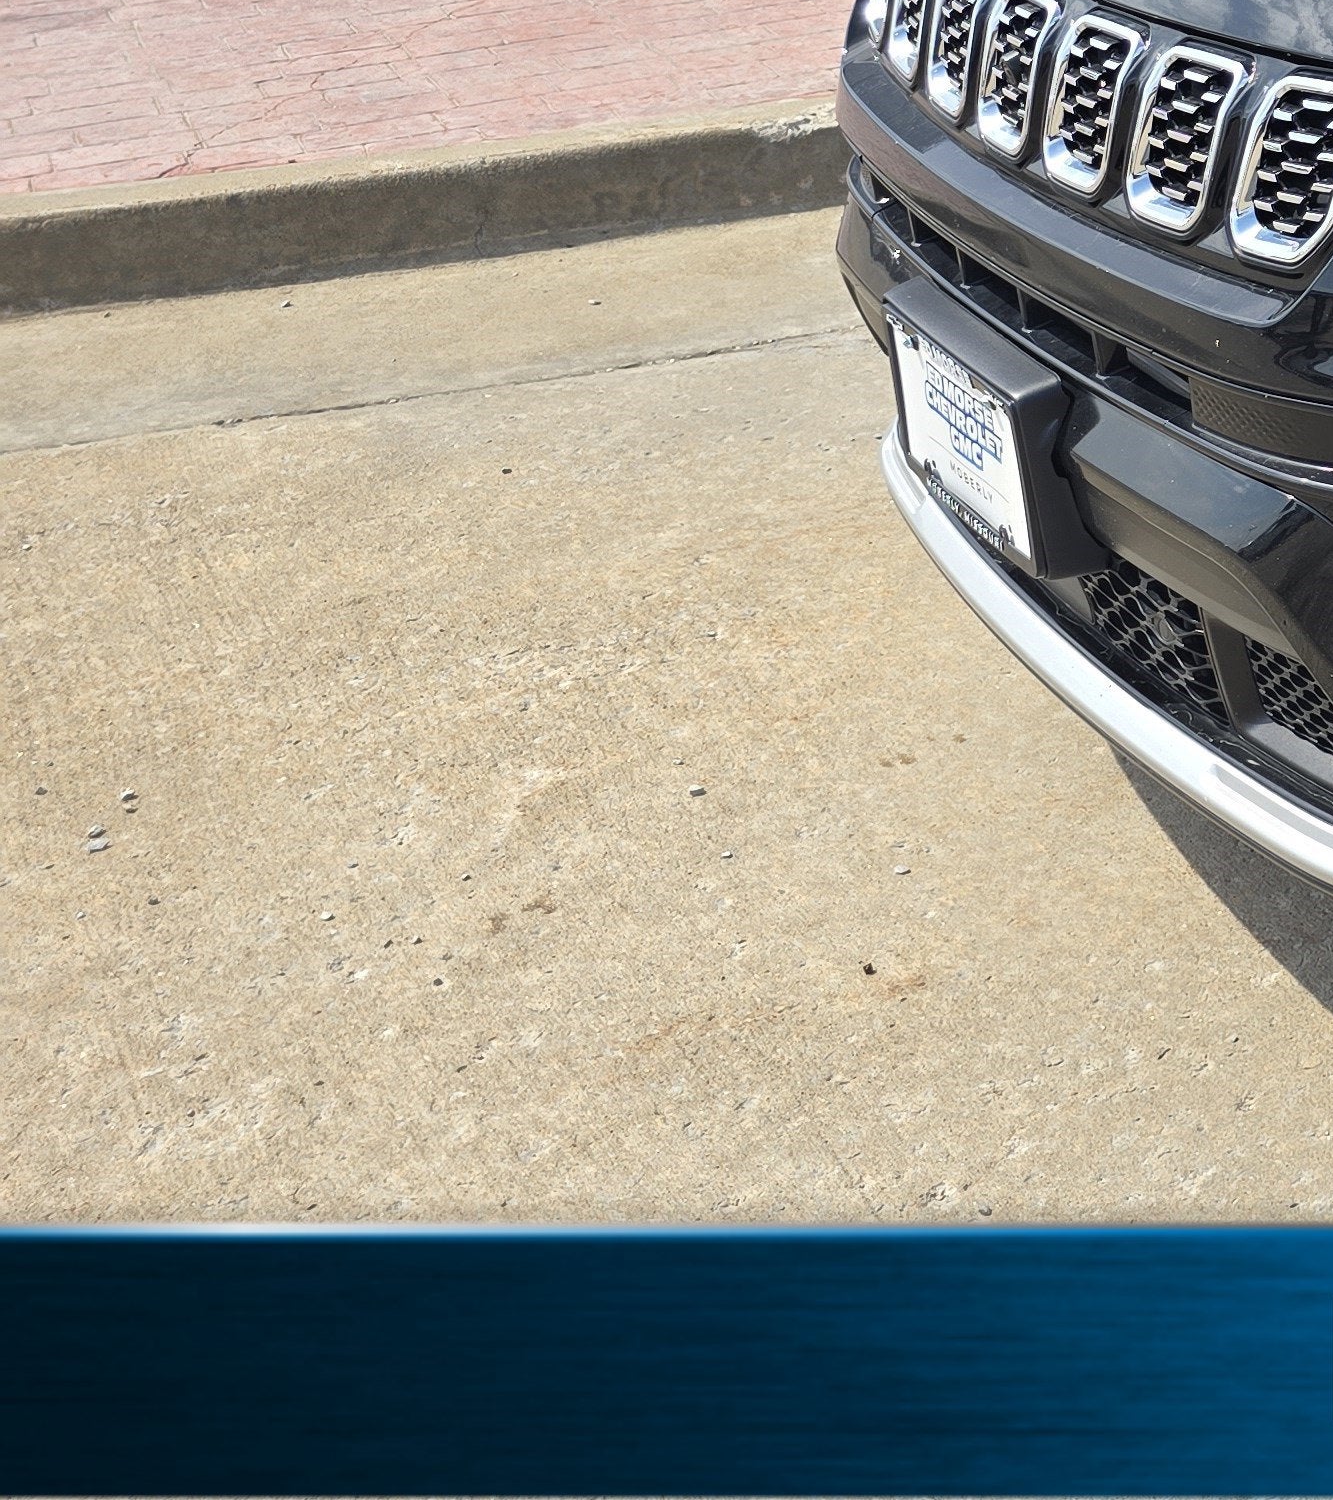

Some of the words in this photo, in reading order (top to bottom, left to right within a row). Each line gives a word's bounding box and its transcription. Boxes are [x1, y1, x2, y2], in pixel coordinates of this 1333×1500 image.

[926, 362, 942, 388] ED
[941, 373, 994, 432] MORSE
[926, 381, 1002, 463] CHEVROLET
[950, 424, 984, 471] GMC
[949, 459, 994, 504] MOBERLY
